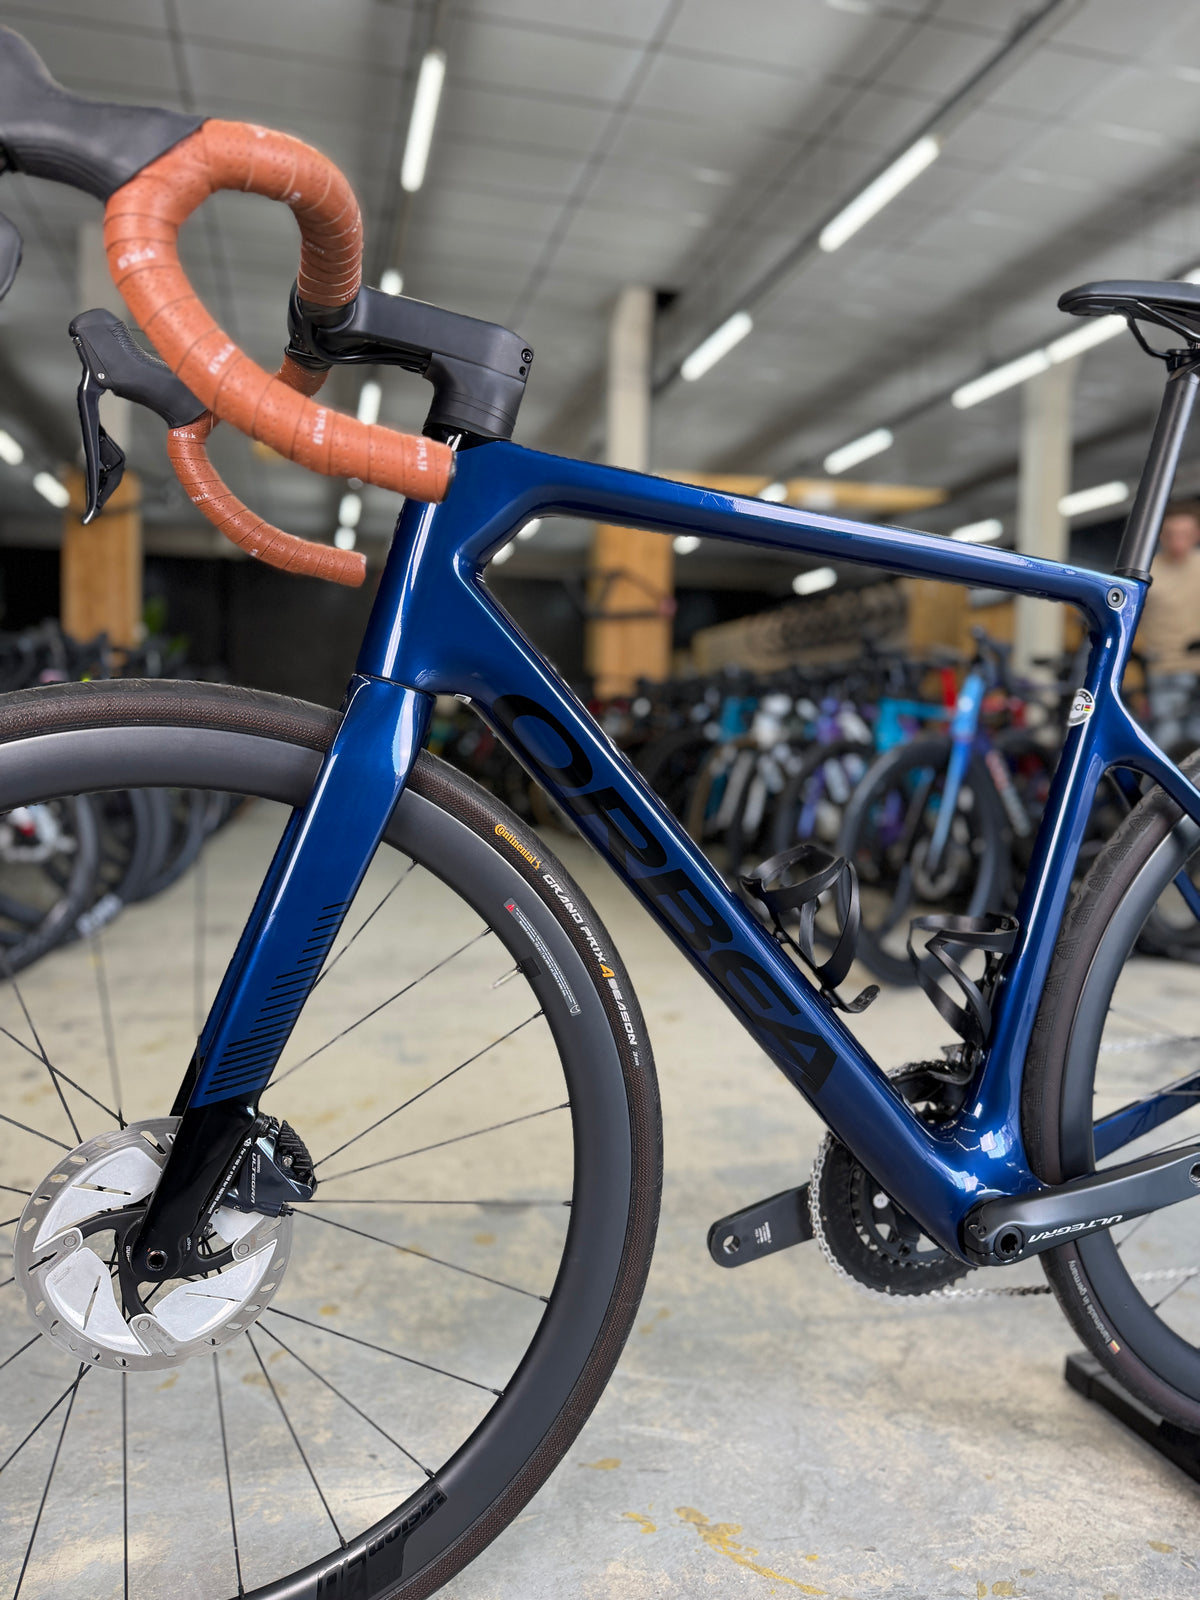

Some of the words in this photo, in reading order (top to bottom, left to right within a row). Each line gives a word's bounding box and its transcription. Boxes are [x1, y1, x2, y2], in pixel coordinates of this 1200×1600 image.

[494, 823, 538, 866] Continental
[493, 694, 838, 1094] ORBEA
[542, 873, 584, 924] GRAND
[580, 925, 607, 963] PRIX
[599, 963, 615, 979] 4
[607, 977, 639, 1046] SEASON
[1027, 1214, 1123, 1244] ULTEGRA
[1068, 1259, 1088, 1296] germany
[1082, 1295, 1090, 1305] in
[1086, 1304, 1112, 1344] handmade
